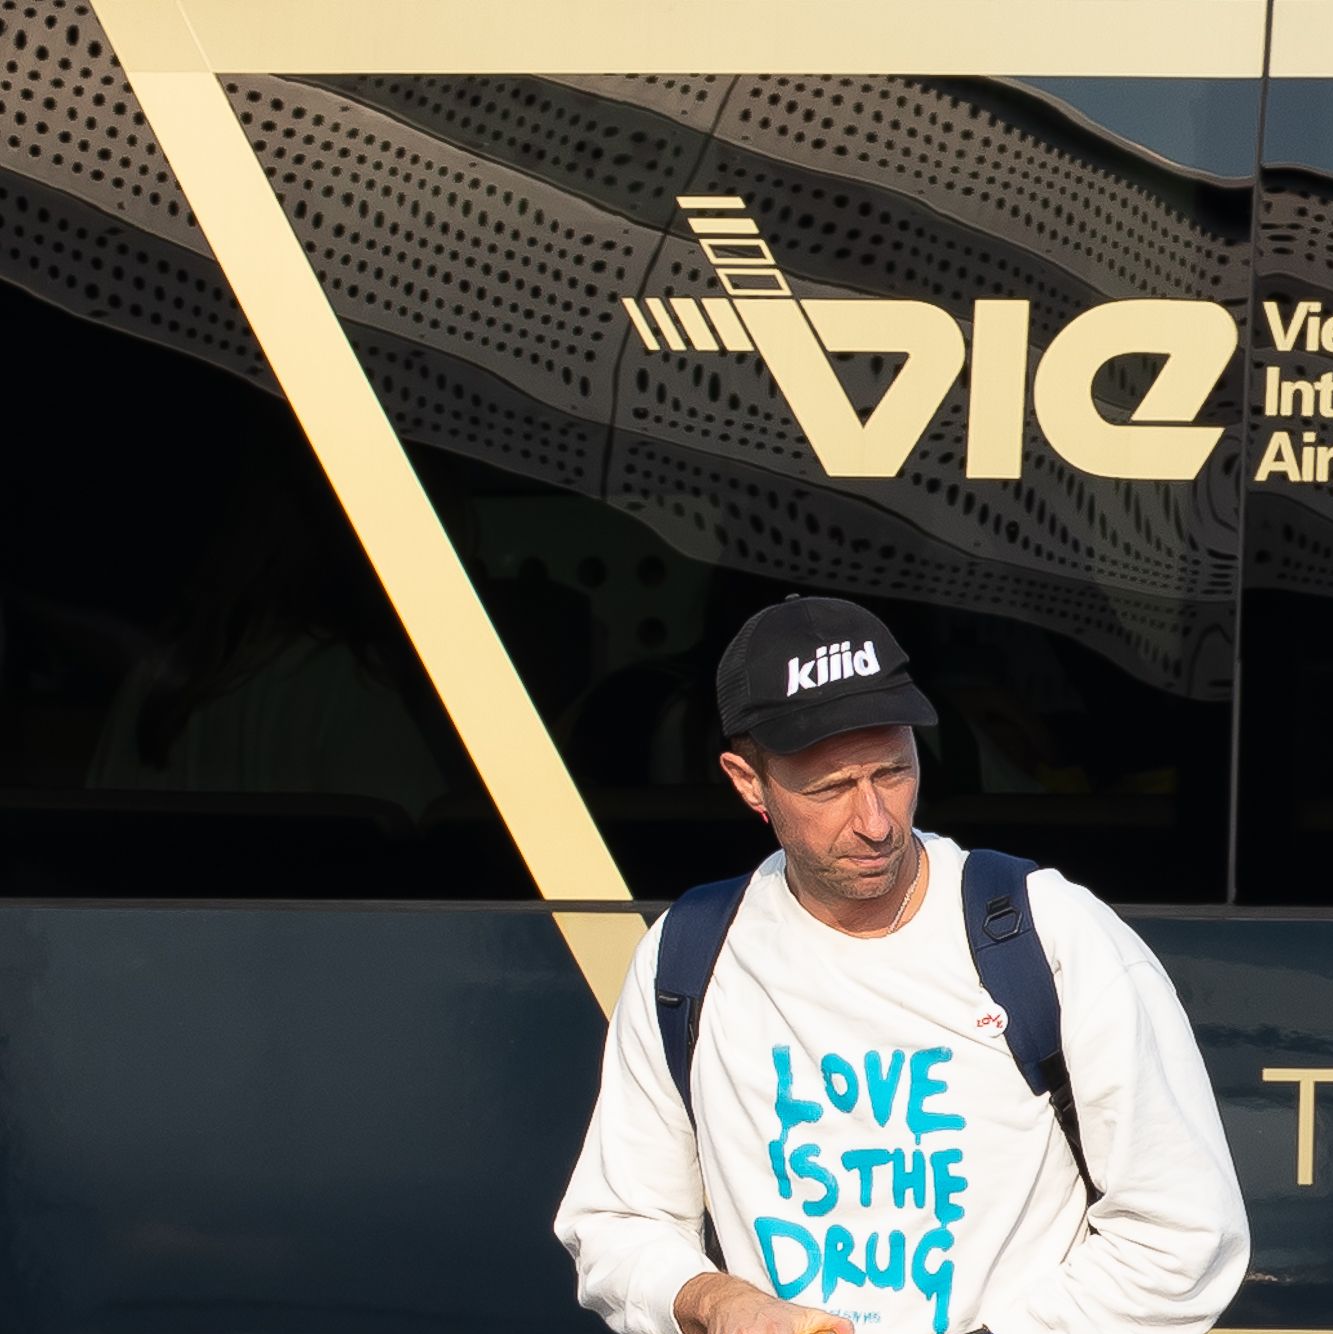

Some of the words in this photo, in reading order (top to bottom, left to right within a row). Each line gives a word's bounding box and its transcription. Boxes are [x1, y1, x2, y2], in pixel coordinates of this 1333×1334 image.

[786, 639, 882, 698] kiiid
[770, 1045, 968, 1140] LOVE
[768, 1139, 840, 1217] IS
[840, 1147, 969, 1224] THE
